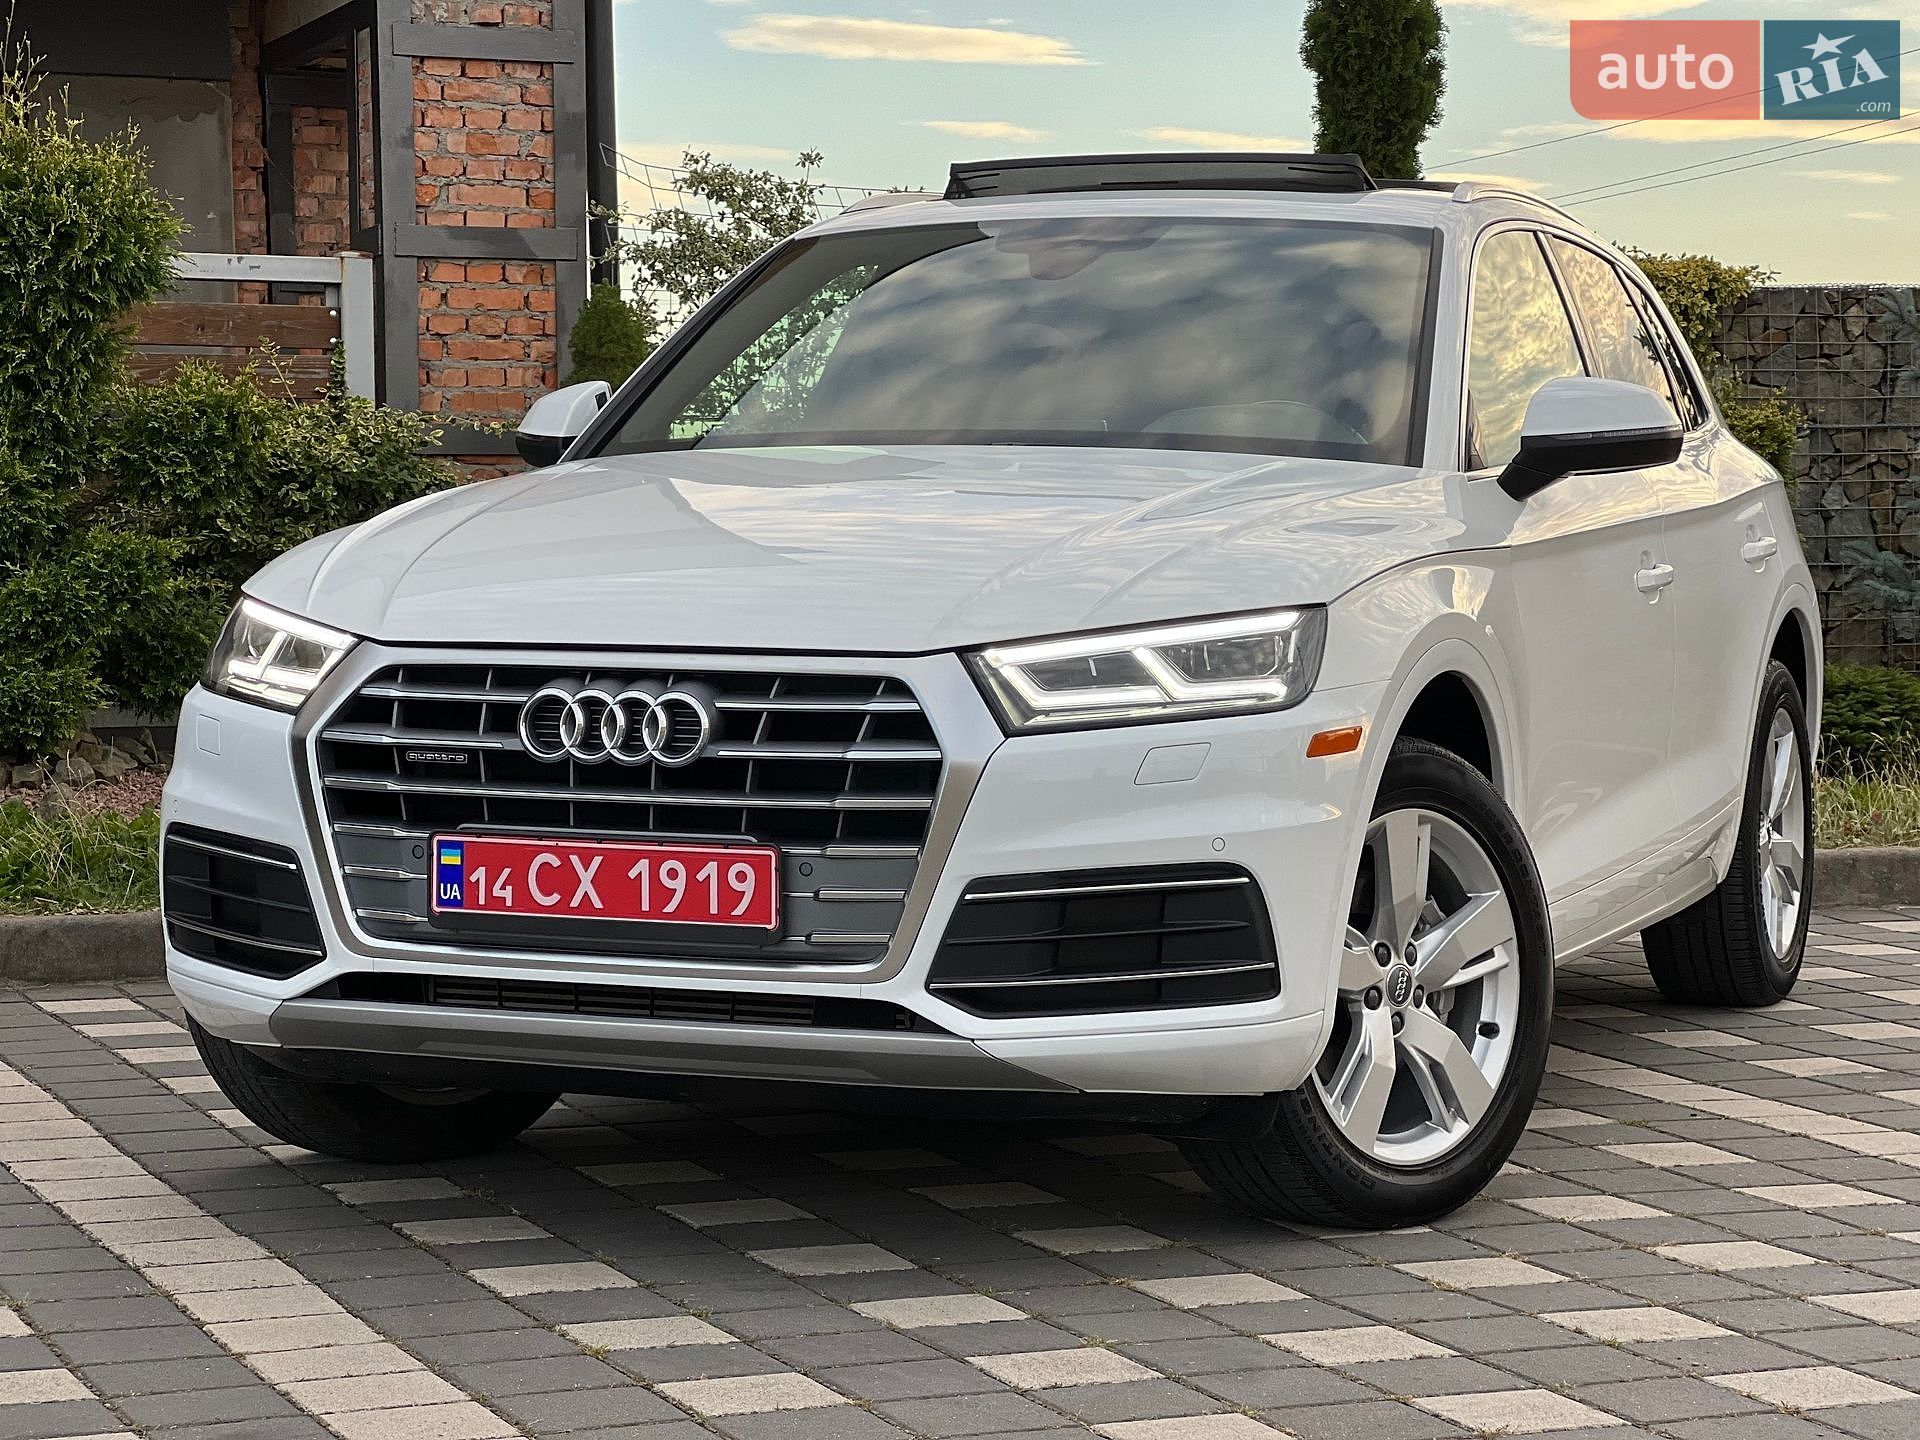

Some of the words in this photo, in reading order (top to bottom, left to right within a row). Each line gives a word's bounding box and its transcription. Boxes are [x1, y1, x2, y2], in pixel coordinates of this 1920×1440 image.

[408, 752, 466, 762] quattro
[439, 882, 462, 901] UA
[468, 866, 513, 907] 14
[527, 852, 604, 909] CX
[627, 858, 757, 916] 1919
